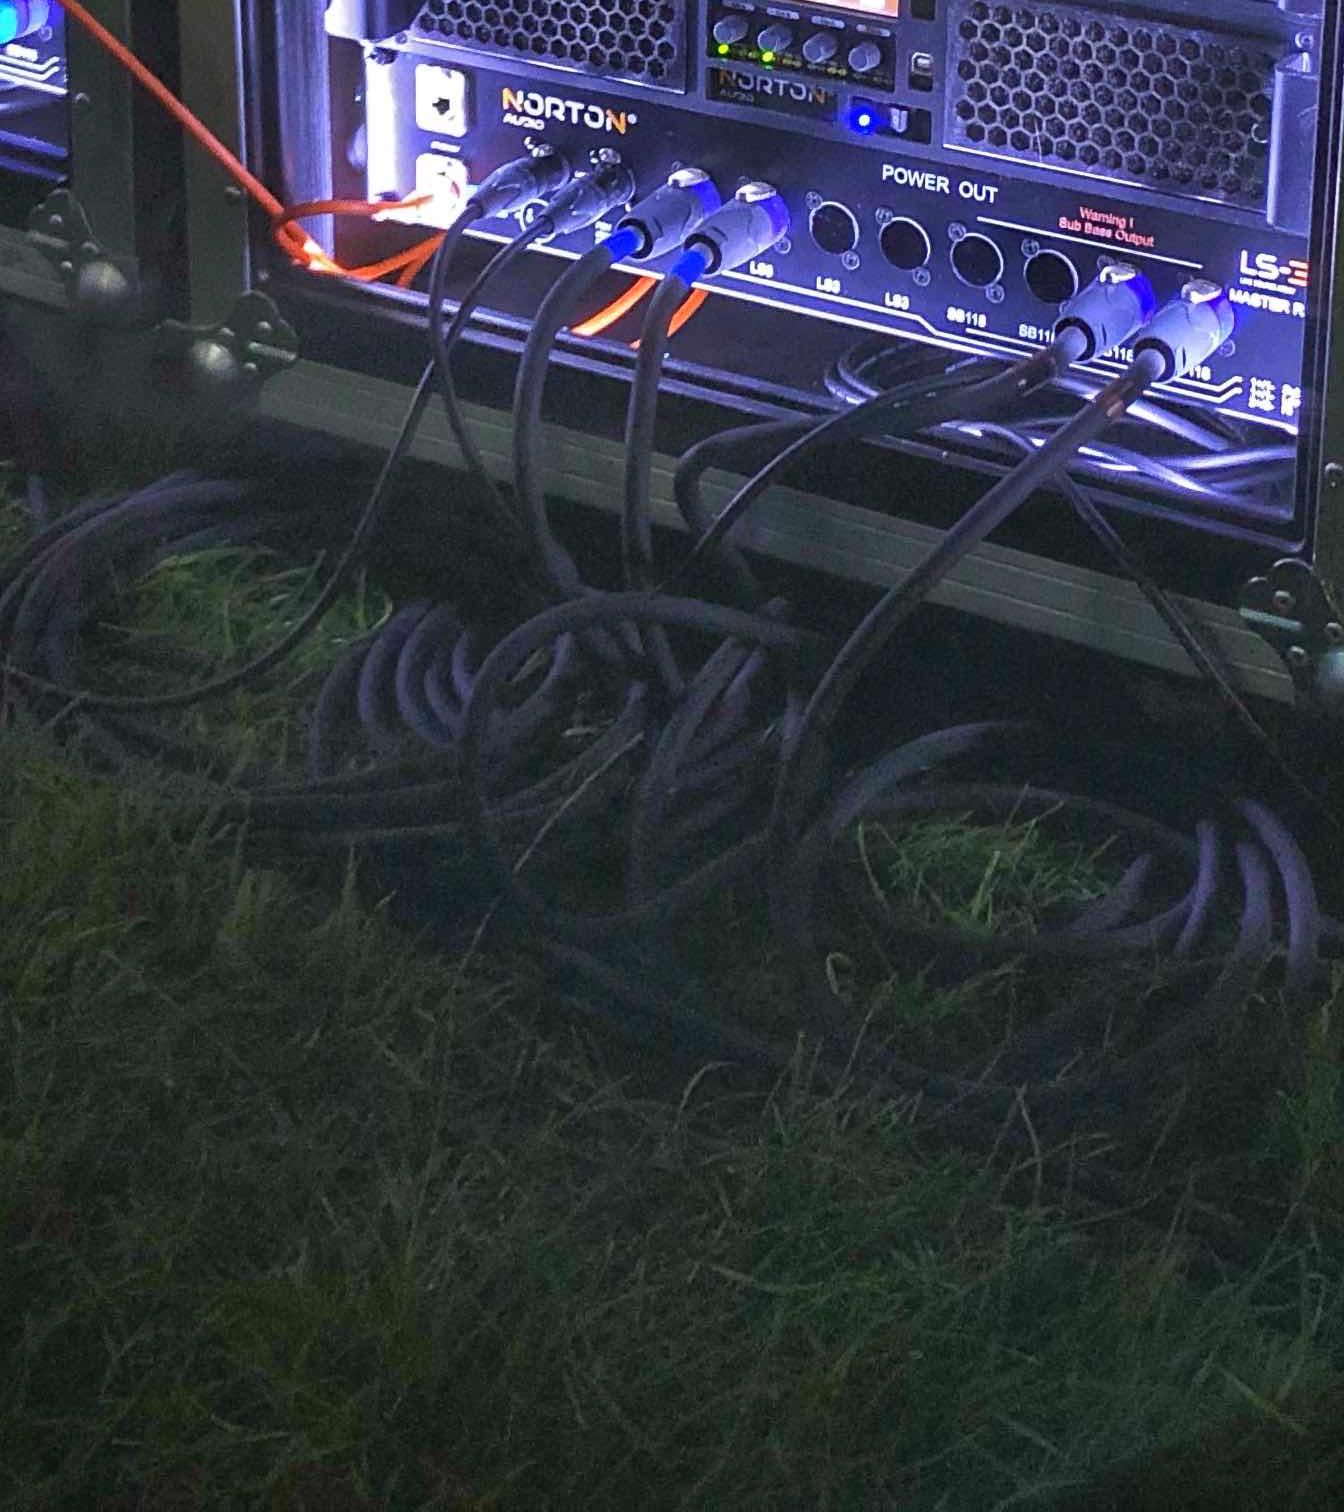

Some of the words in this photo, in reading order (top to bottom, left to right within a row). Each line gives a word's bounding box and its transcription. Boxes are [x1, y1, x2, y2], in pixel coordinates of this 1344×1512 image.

[502, 87, 628, 135] NORTON
[882, 163, 950, 194] POWER
[958, 180, 998, 204] OUT
[1058, 216, 1082, 233] Sub
[1115, 229, 1155, 249] Output
[1079, 206, 1127, 228] Warning
[1229, 288, 1290, 315] MASTER
